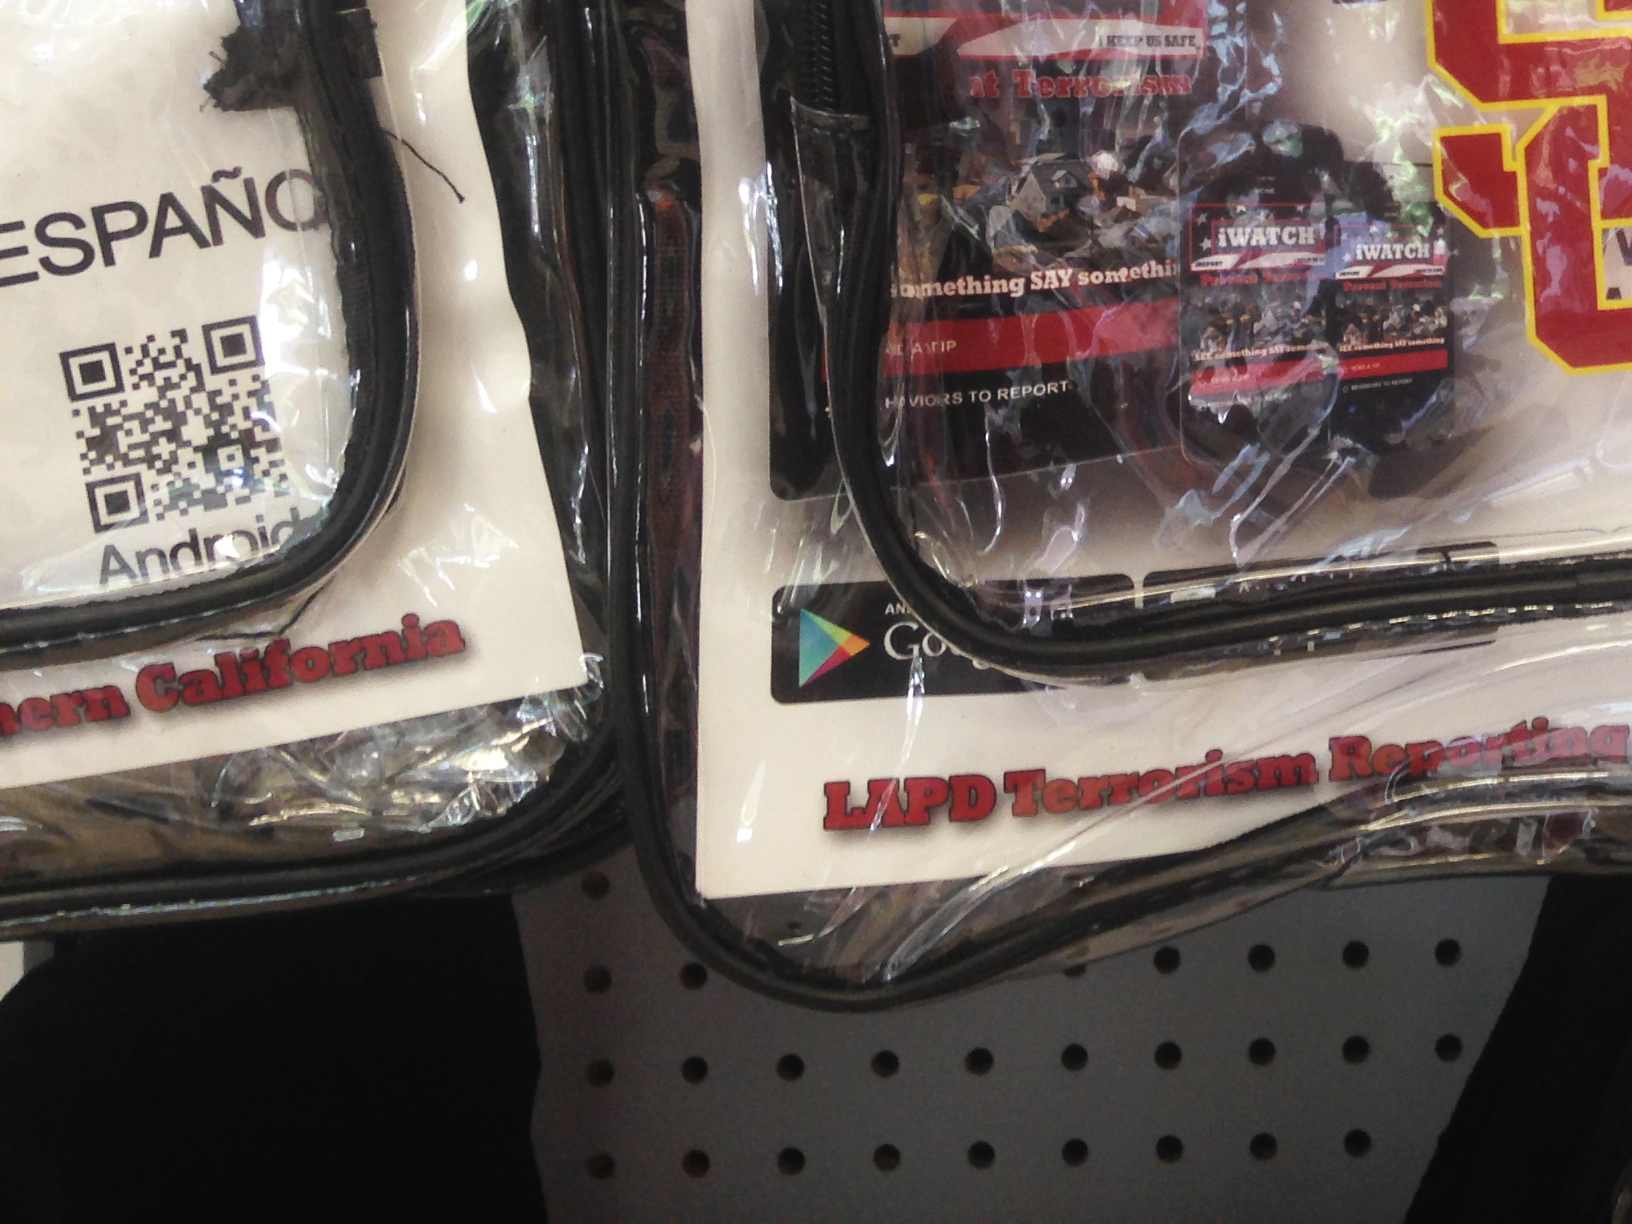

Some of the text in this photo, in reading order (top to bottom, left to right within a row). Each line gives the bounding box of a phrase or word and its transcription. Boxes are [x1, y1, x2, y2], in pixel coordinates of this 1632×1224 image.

[1217, 226, 1316, 248] iWATCH
[1355, 241, 1430, 262] iWATCH
[1030, 267, 1073, 291] SAY
[969, 389, 992, 405] TO
[997, 379, 1070, 402] REPORT
[99, 507, 303, 585] Android
[135, 612, 467, 713] California
[822, 774, 997, 832] LAPD
[1003, 748, 1320, 818] Terrorism
[1327, 716, 1630, 783] Reporting
